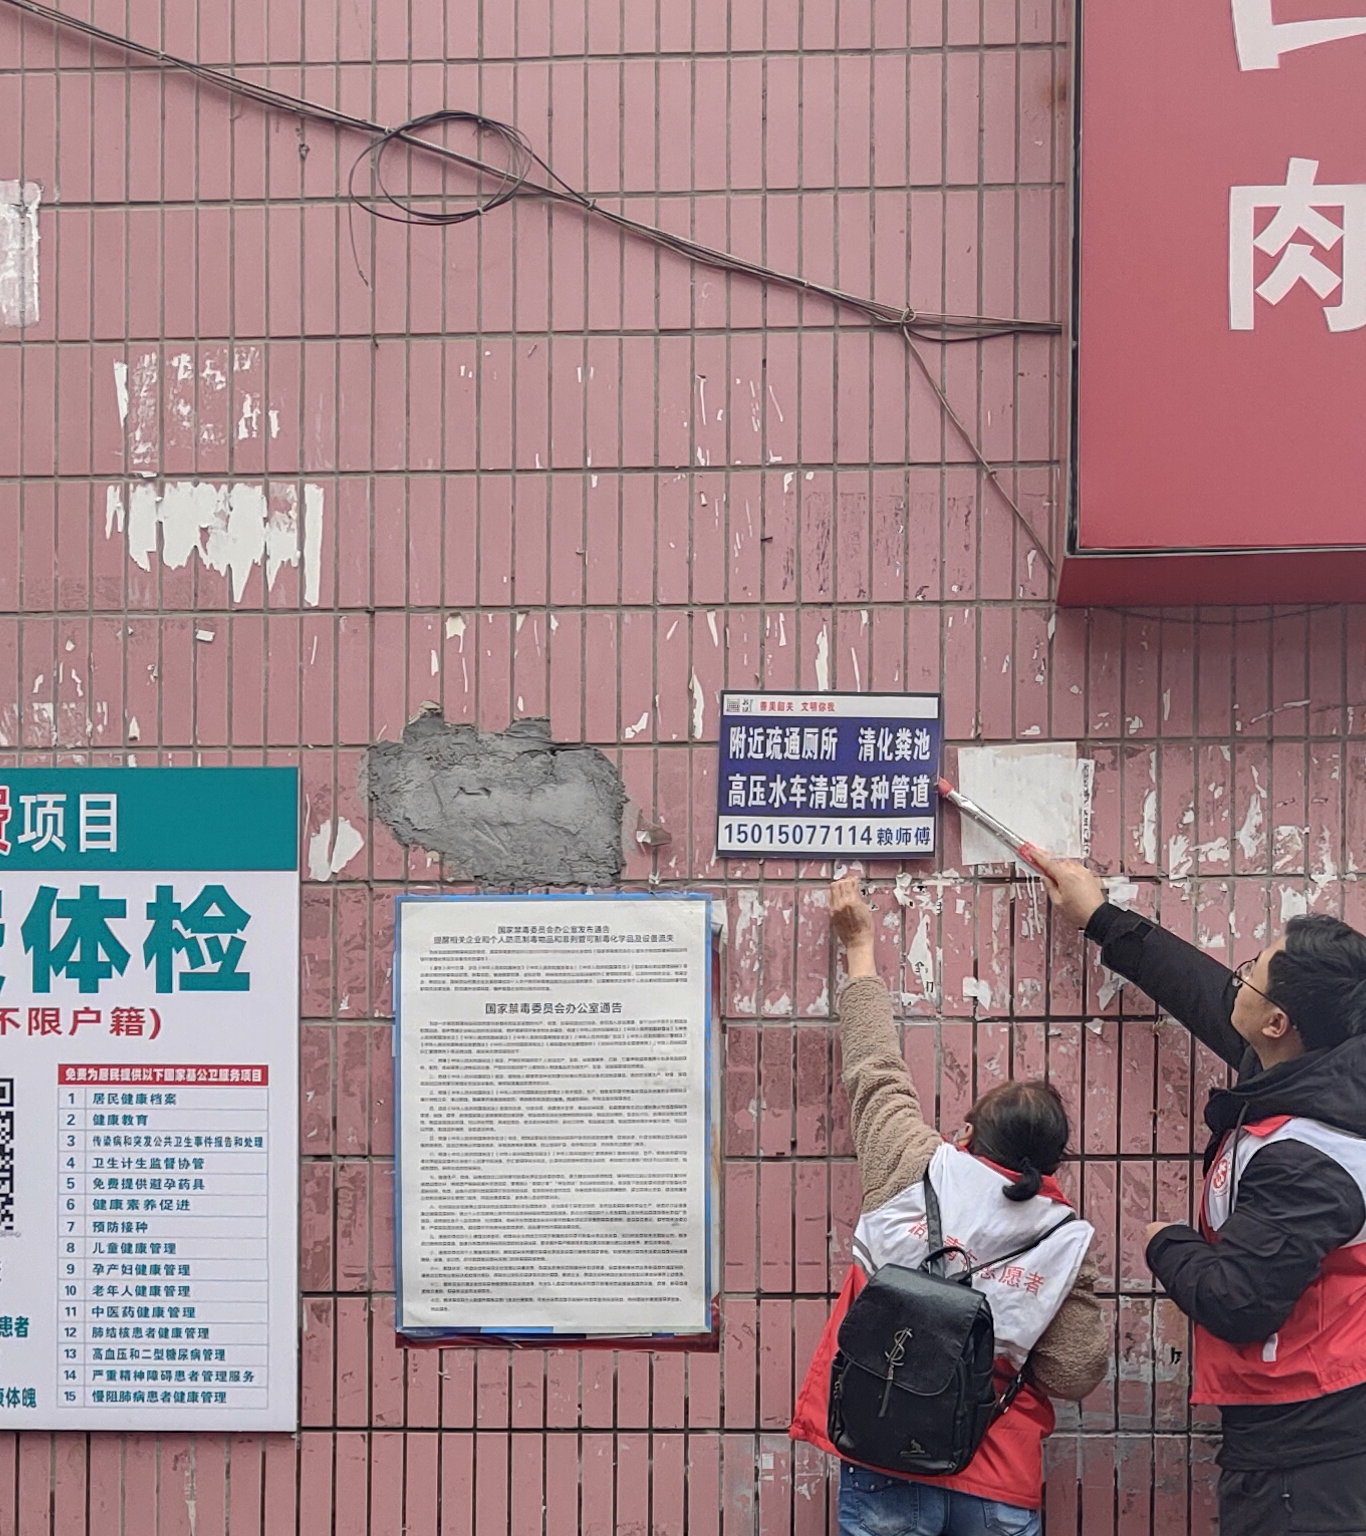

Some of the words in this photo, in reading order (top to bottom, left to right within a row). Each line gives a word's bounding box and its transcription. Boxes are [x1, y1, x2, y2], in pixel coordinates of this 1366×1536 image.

[729, 726, 838, 761] 附近疏通厕所
[858, 727, 931, 762] 清化粪池
[728, 773, 931, 810] 高压水车清通各种管道
[724, 823, 873, 846] 15015077114
[876, 826, 931, 846] 赖师傅
[485, 1002, 623, 1015] 国家禁毒委员会办公室通告
[67, 1092, 75, 1105] 1
[66, 1114, 76, 1126] 2
[66, 1135, 76, 1147] 3
[66, 1157, 76, 1169] 4
[66, 1178, 76, 1190] 5
[66, 1199, 76, 1210] 6
[66, 1221, 76, 1233] 7
[66, 1242, 76, 1253] 8
[66, 1263, 76, 1275] 9
[64, 1285, 77, 1296] 10
[64, 1306, 77, 1317] 11
[64, 1327, 77, 1338] 12
[63, 1348, 77, 1359] 13
[63, 1369, 77, 1381] 14
[63, 1390, 76, 1402] 15
